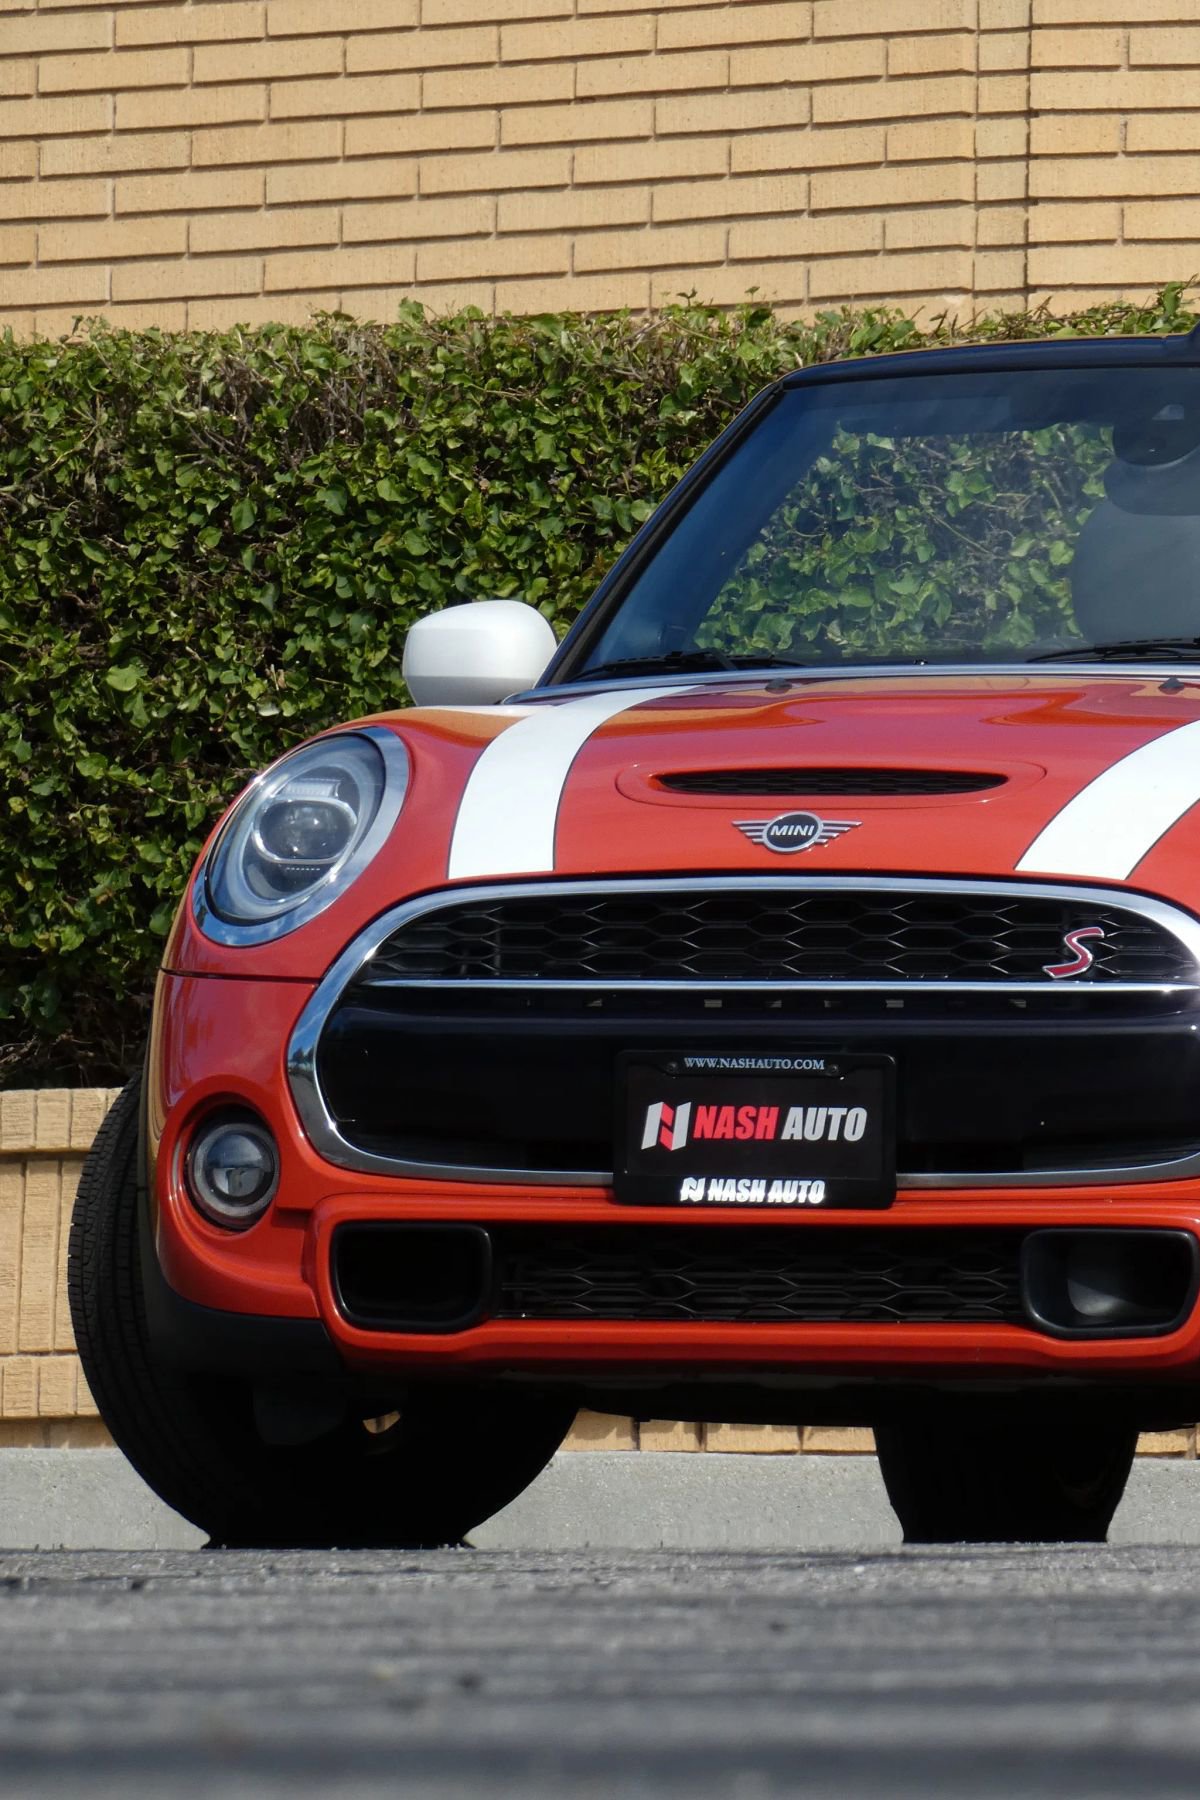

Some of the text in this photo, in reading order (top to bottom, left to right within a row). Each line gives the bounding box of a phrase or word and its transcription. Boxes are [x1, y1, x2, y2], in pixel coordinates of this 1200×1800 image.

[770, 825, 815, 836] MINI
[1042, 927, 1104, 979] S
[684, 1057, 825, 1070] WWW.NASHAUTO.COM
[693, 1105, 780, 1140] NASH
[780, 1108, 868, 1141] AUTO
[708, 1178, 766, 1203] NASH
[767, 1180, 826, 1204] AUTO
